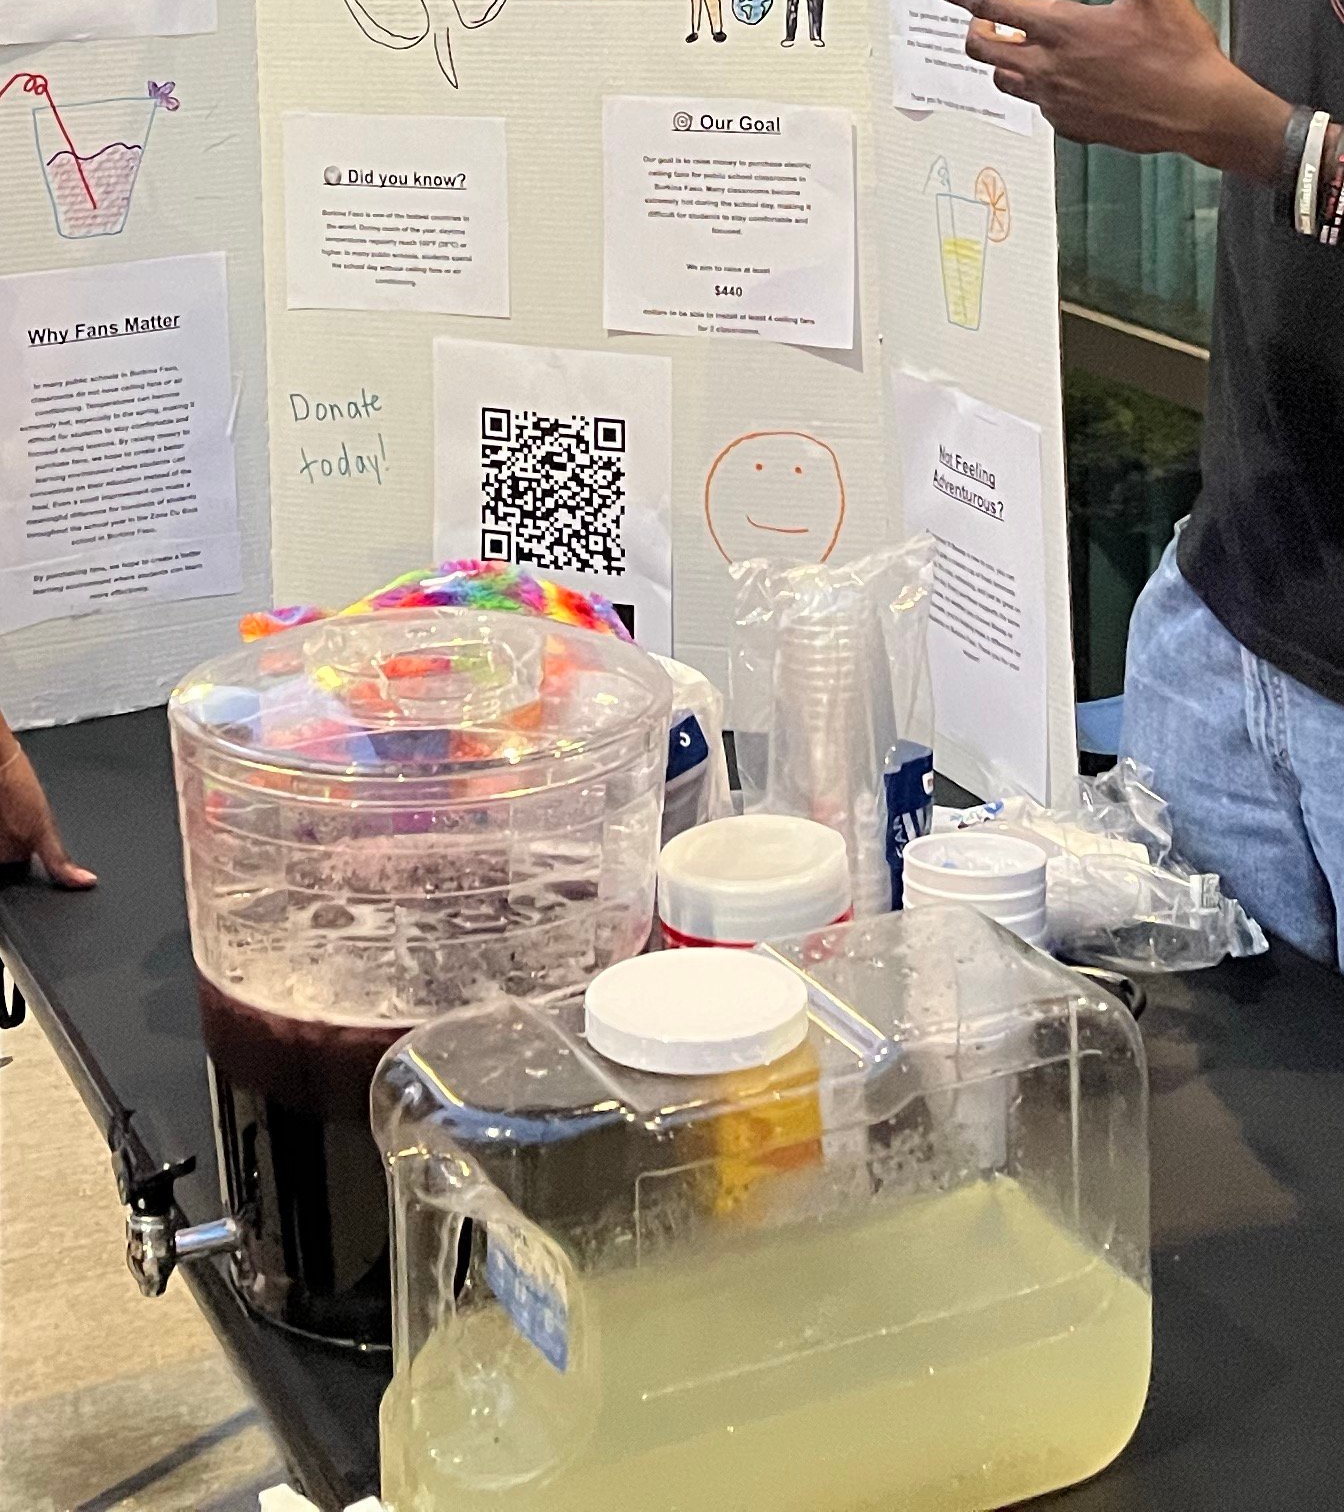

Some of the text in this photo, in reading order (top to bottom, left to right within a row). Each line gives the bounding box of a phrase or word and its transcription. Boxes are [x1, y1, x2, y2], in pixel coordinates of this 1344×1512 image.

[700, 114, 781, 132] Our Goal
[348, 169, 467, 188] Did you know?
[714, 285, 743, 297] $440
[27, 315, 181, 345] Why Fans Matter
[289, 388, 383, 422] Donate
[299, 432, 390, 486] today!
[939, 444, 997, 489] Not Feeling
[933, 468, 1005, 519] Adventurous?
